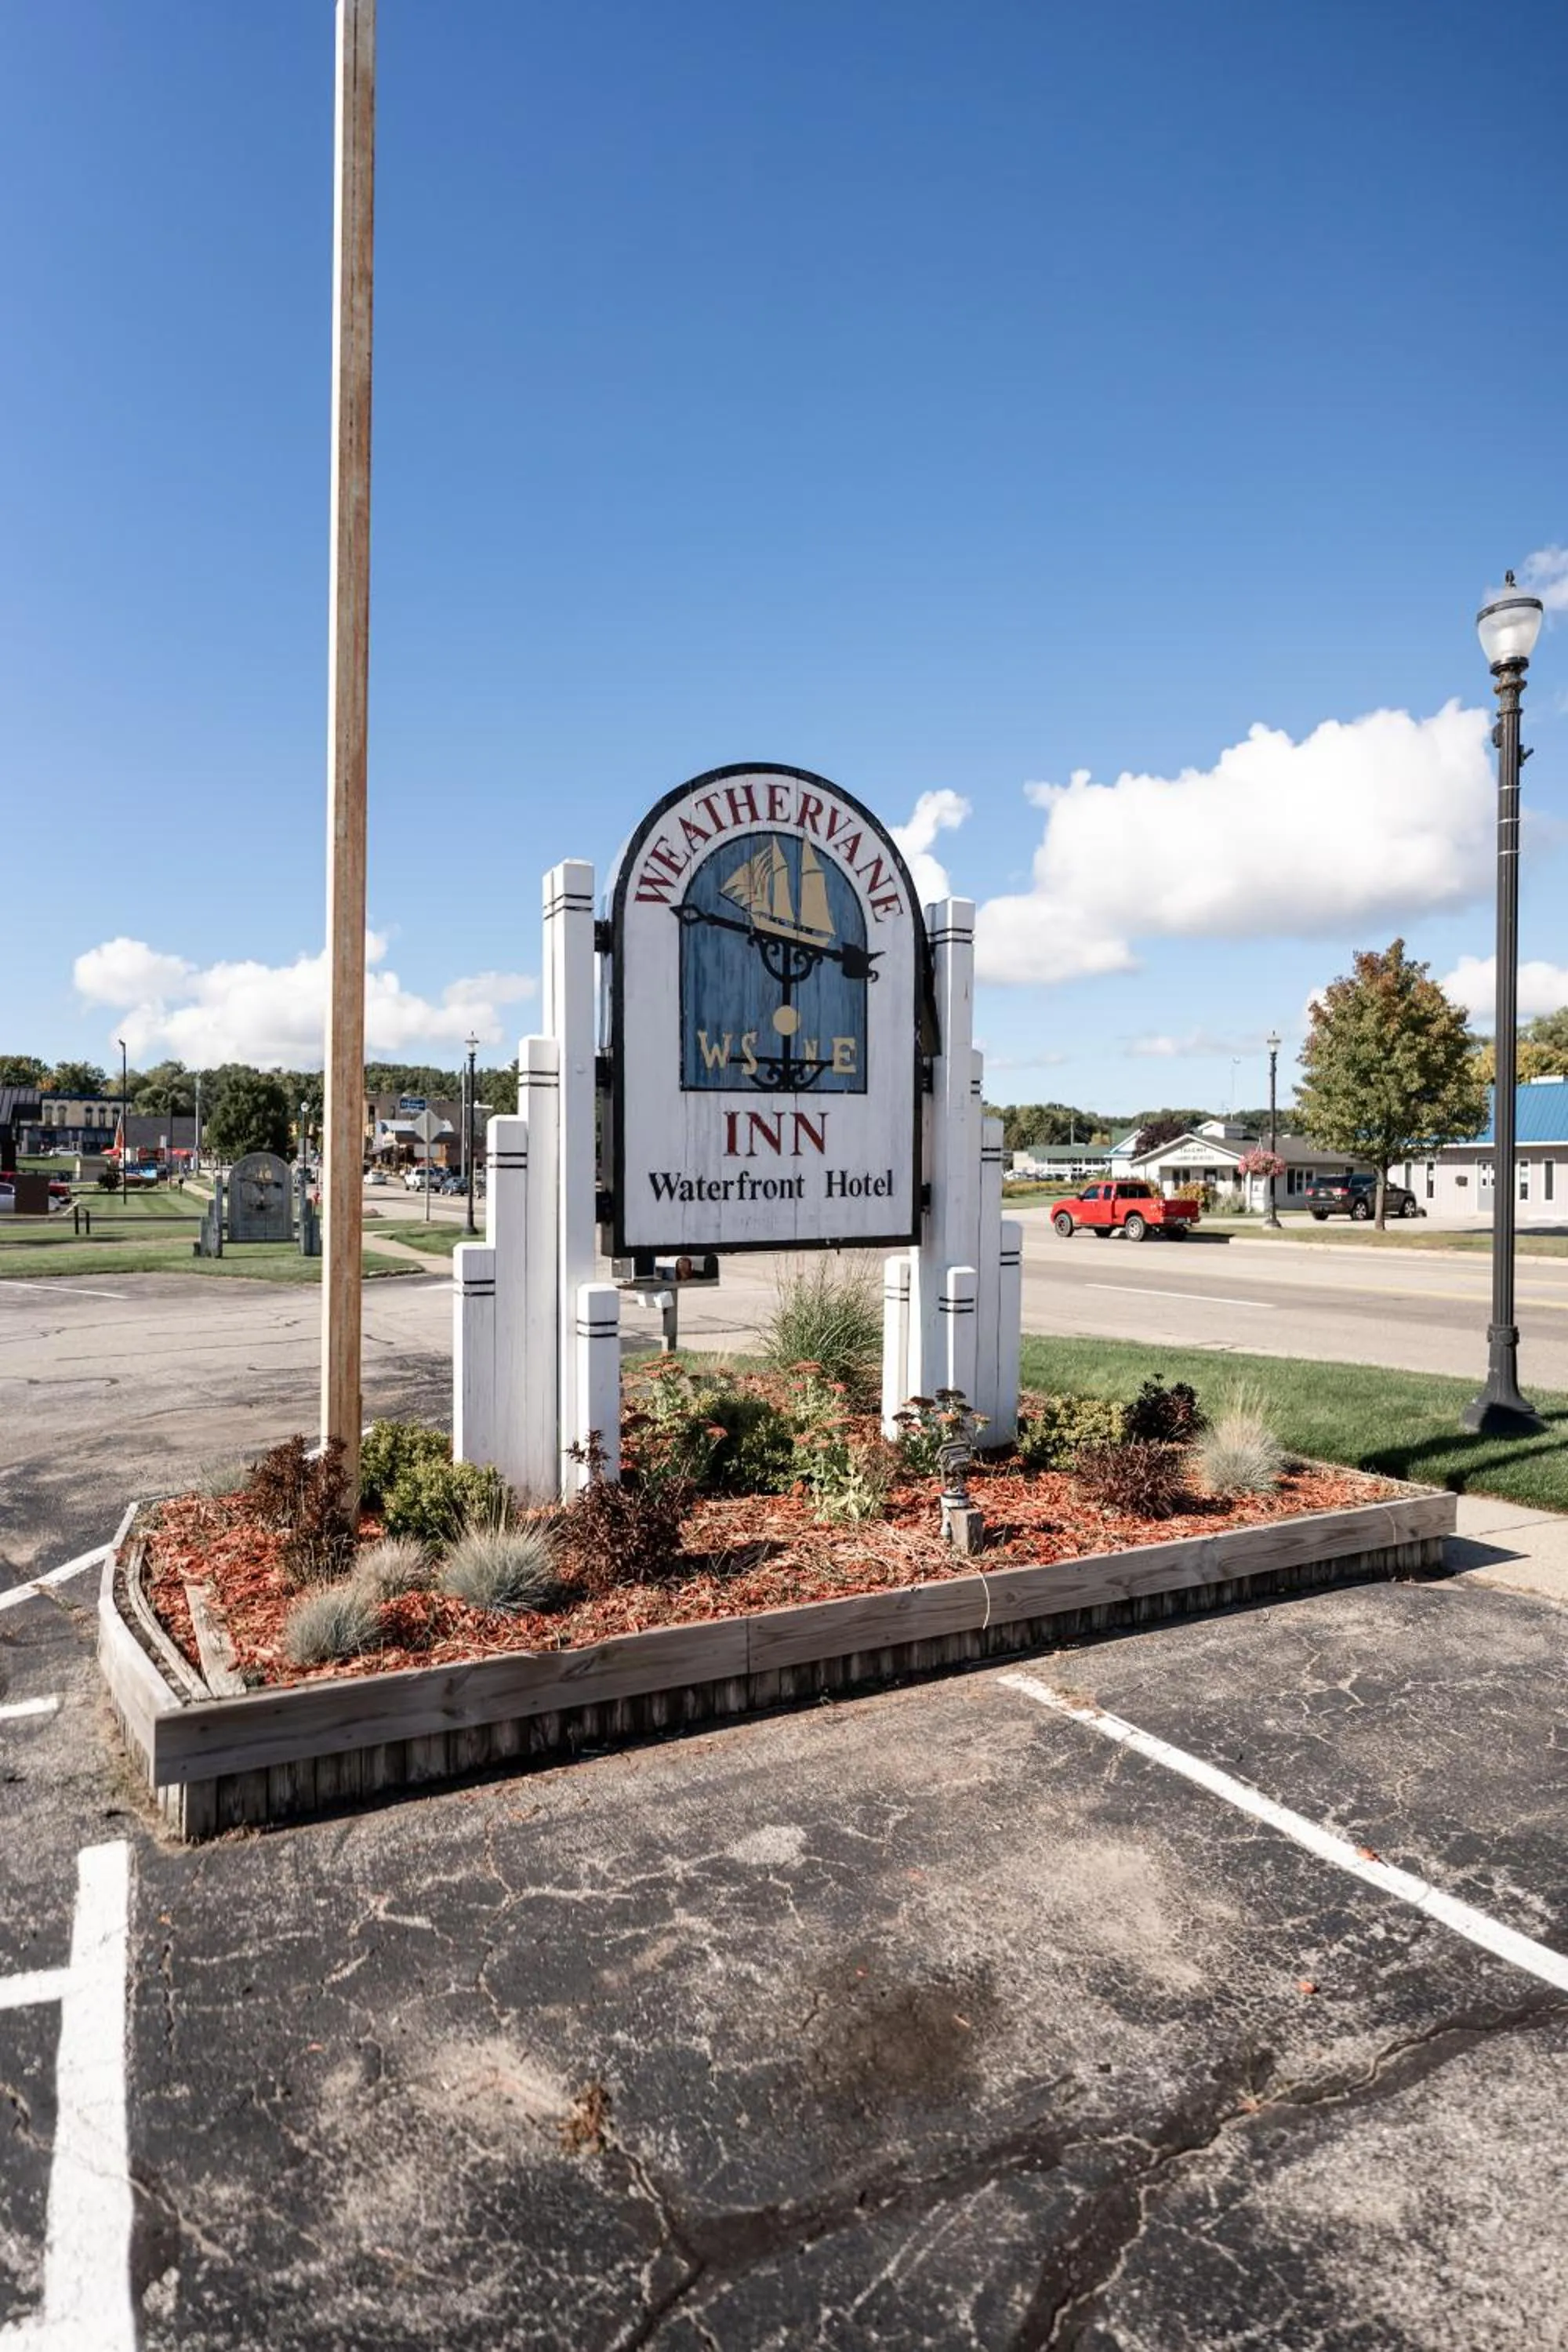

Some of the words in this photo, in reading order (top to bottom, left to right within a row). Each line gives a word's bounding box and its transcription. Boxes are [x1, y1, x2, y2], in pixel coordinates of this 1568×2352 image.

[635, 783, 904, 923] WEATHERVANE
[699, 1031, 732, 1071] W
[741, 1031, 759, 1075] S
[832, 1036, 857, 1073] E
[723, 1110, 830, 1156] INN
[648, 1170, 806, 1202] Waterfront
[824, 1168, 894, 1199] Hotel
